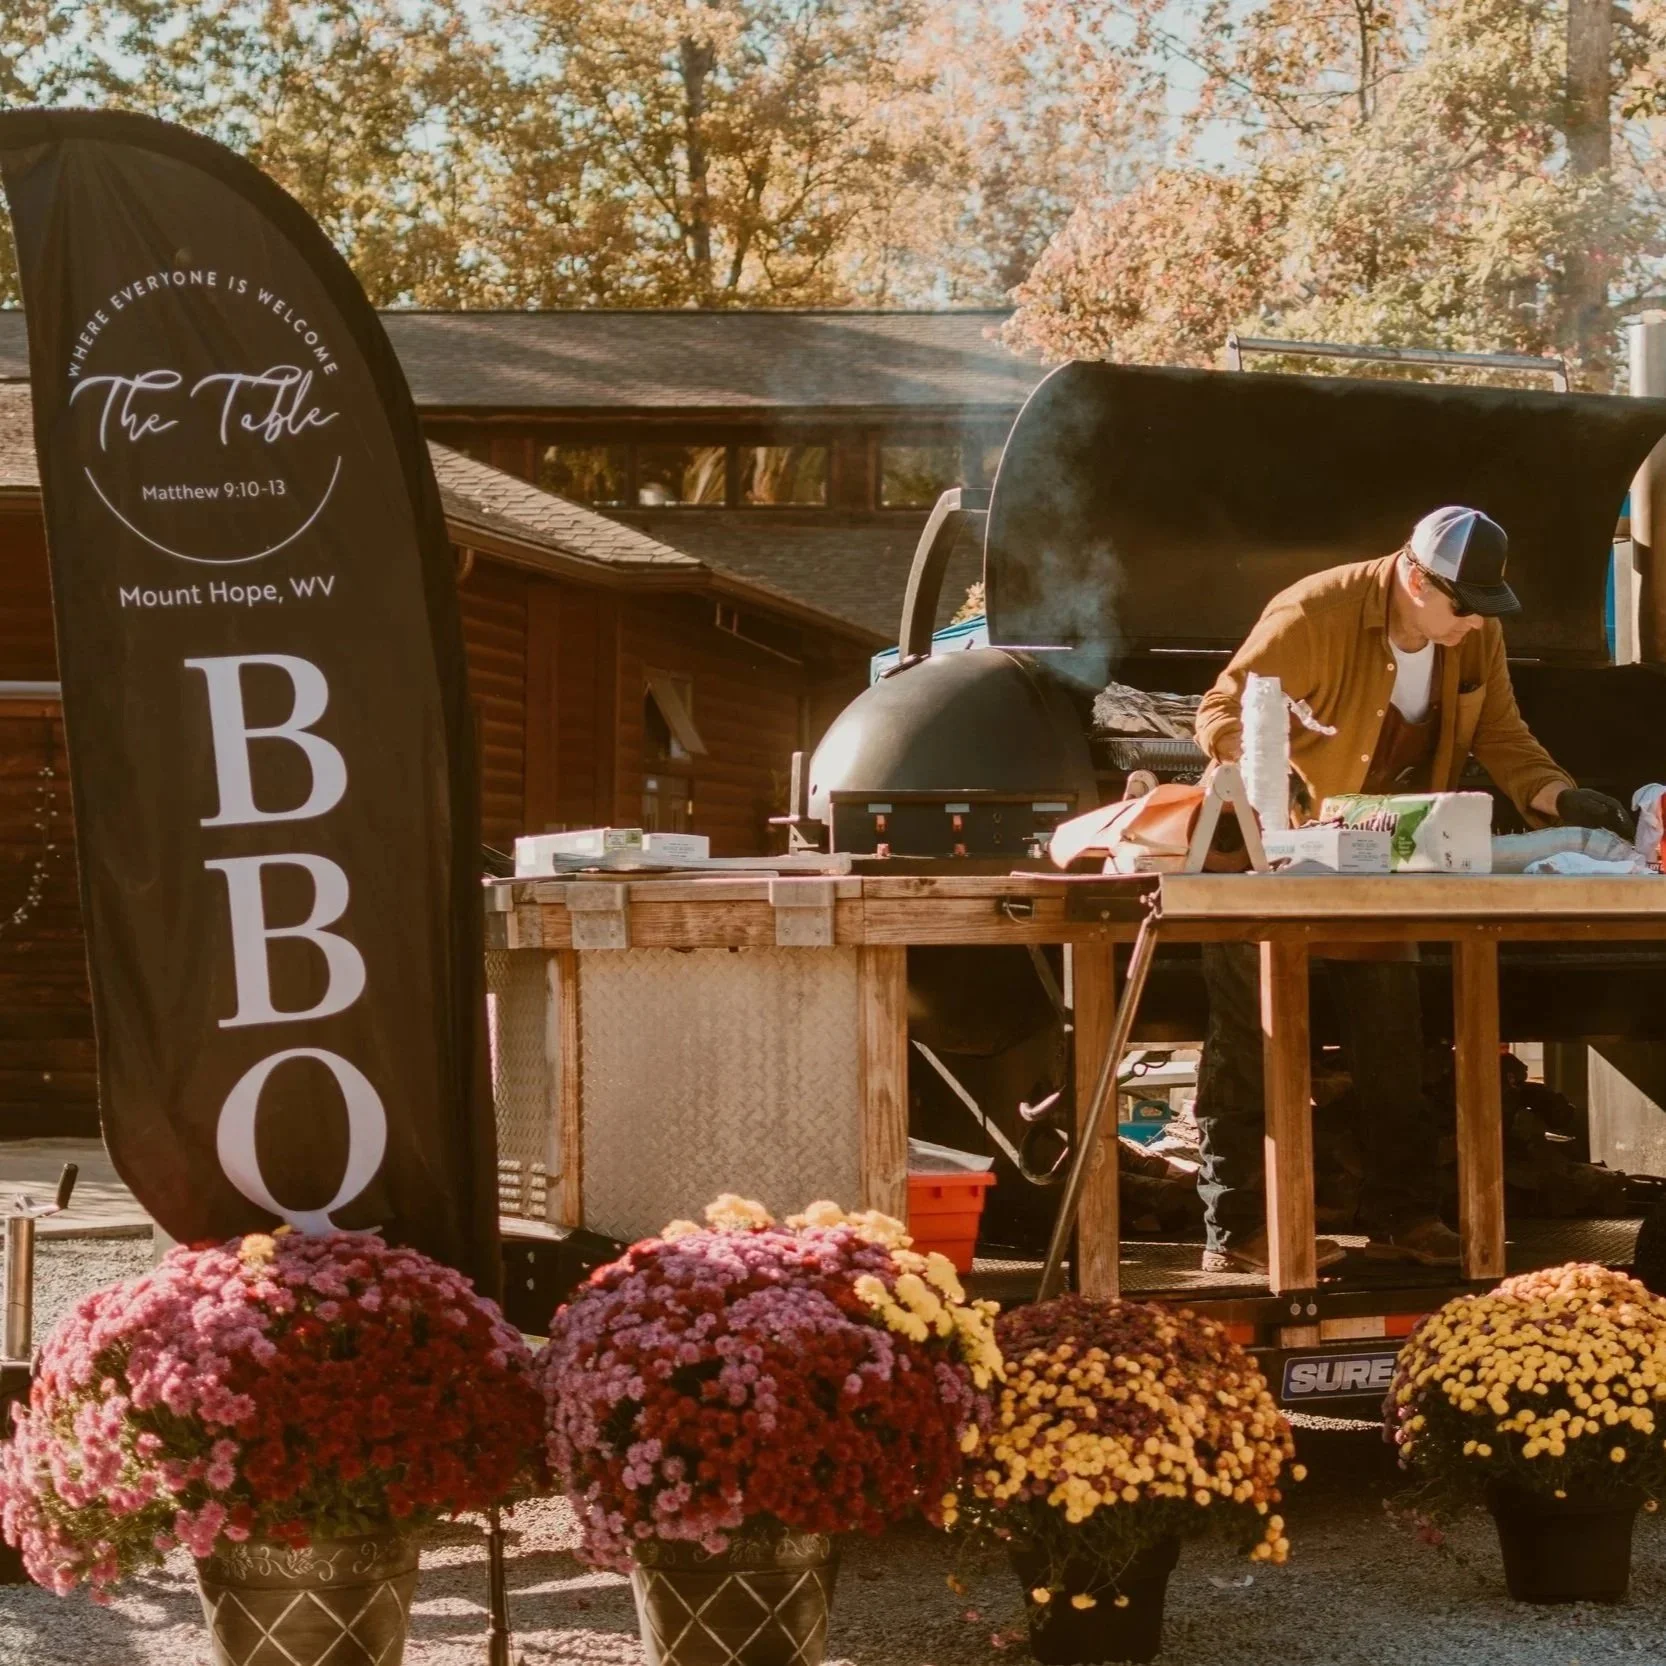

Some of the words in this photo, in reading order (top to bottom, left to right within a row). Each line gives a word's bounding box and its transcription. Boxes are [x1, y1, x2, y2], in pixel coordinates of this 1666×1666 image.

[68, 309, 109, 377] WHERE
[110, 270, 217, 310] EVERYONE
[228, 275, 248, 294] IS
[258, 287, 338, 375] WELCOME
[68, 369, 182, 451] The
[190, 364, 340, 446] Table
[142, 484, 219, 501] Matthew
[223, 479, 286, 498] 9:10-13
[119, 584, 202, 608] Mount
[209, 580, 284, 608] Hope,
[289, 574, 336, 598] WV
[184, 653, 388, 1234] BBQ
[1289, 1358, 1397, 1394] SURE
